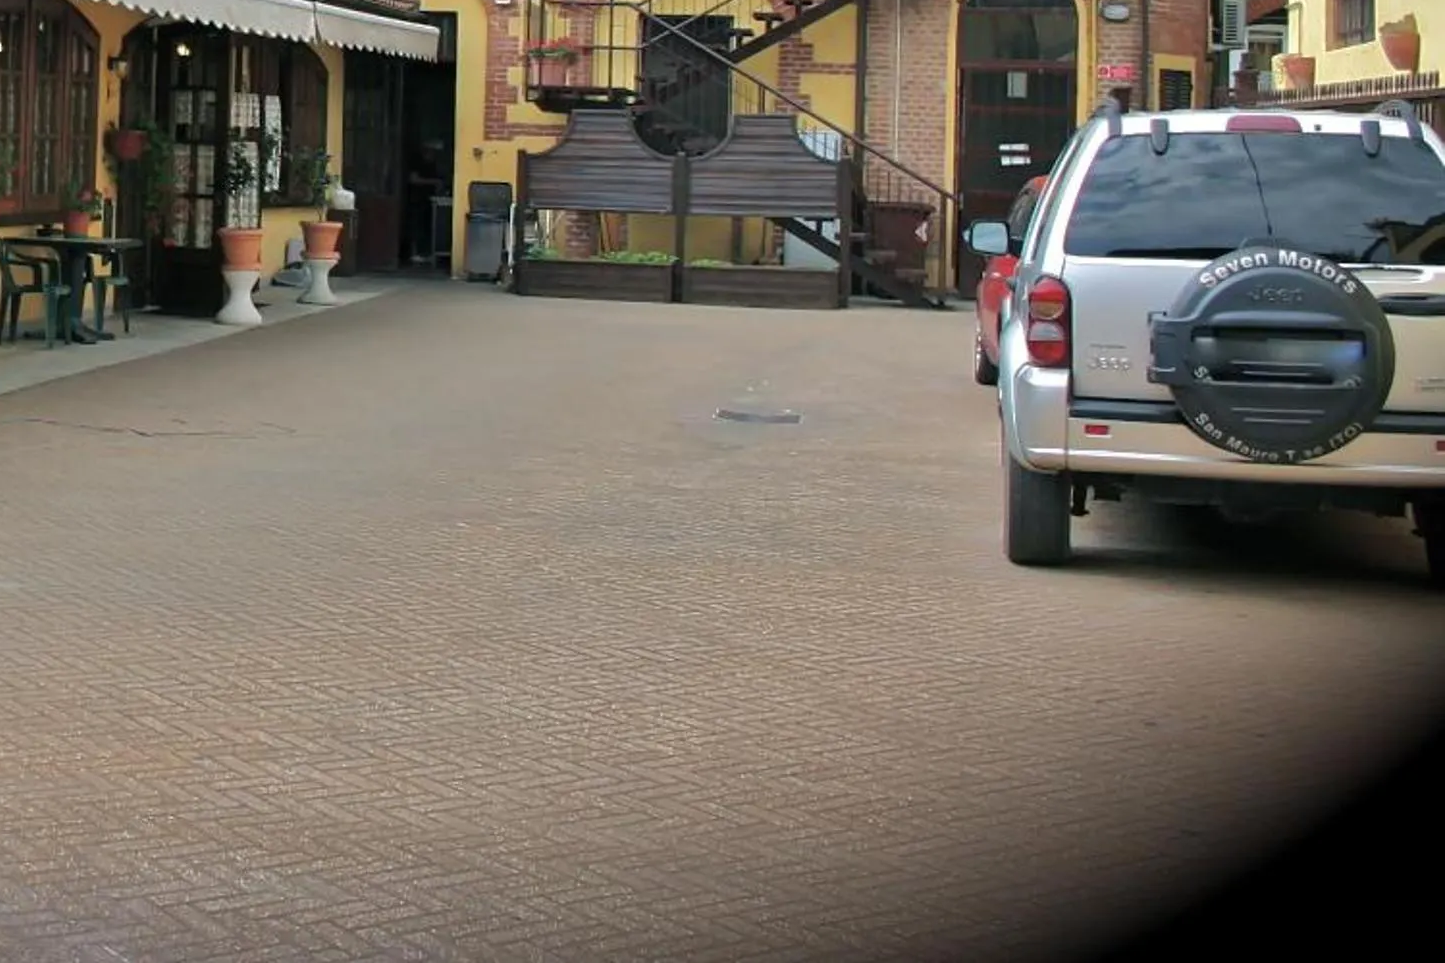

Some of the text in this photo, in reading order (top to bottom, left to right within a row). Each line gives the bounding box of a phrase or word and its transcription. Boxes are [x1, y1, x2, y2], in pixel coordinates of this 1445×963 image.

[1199, 249, 1358, 294] Seven Motors
[1195, 412, 1223, 439] San
[1226, 436, 1279, 462] Mauro
